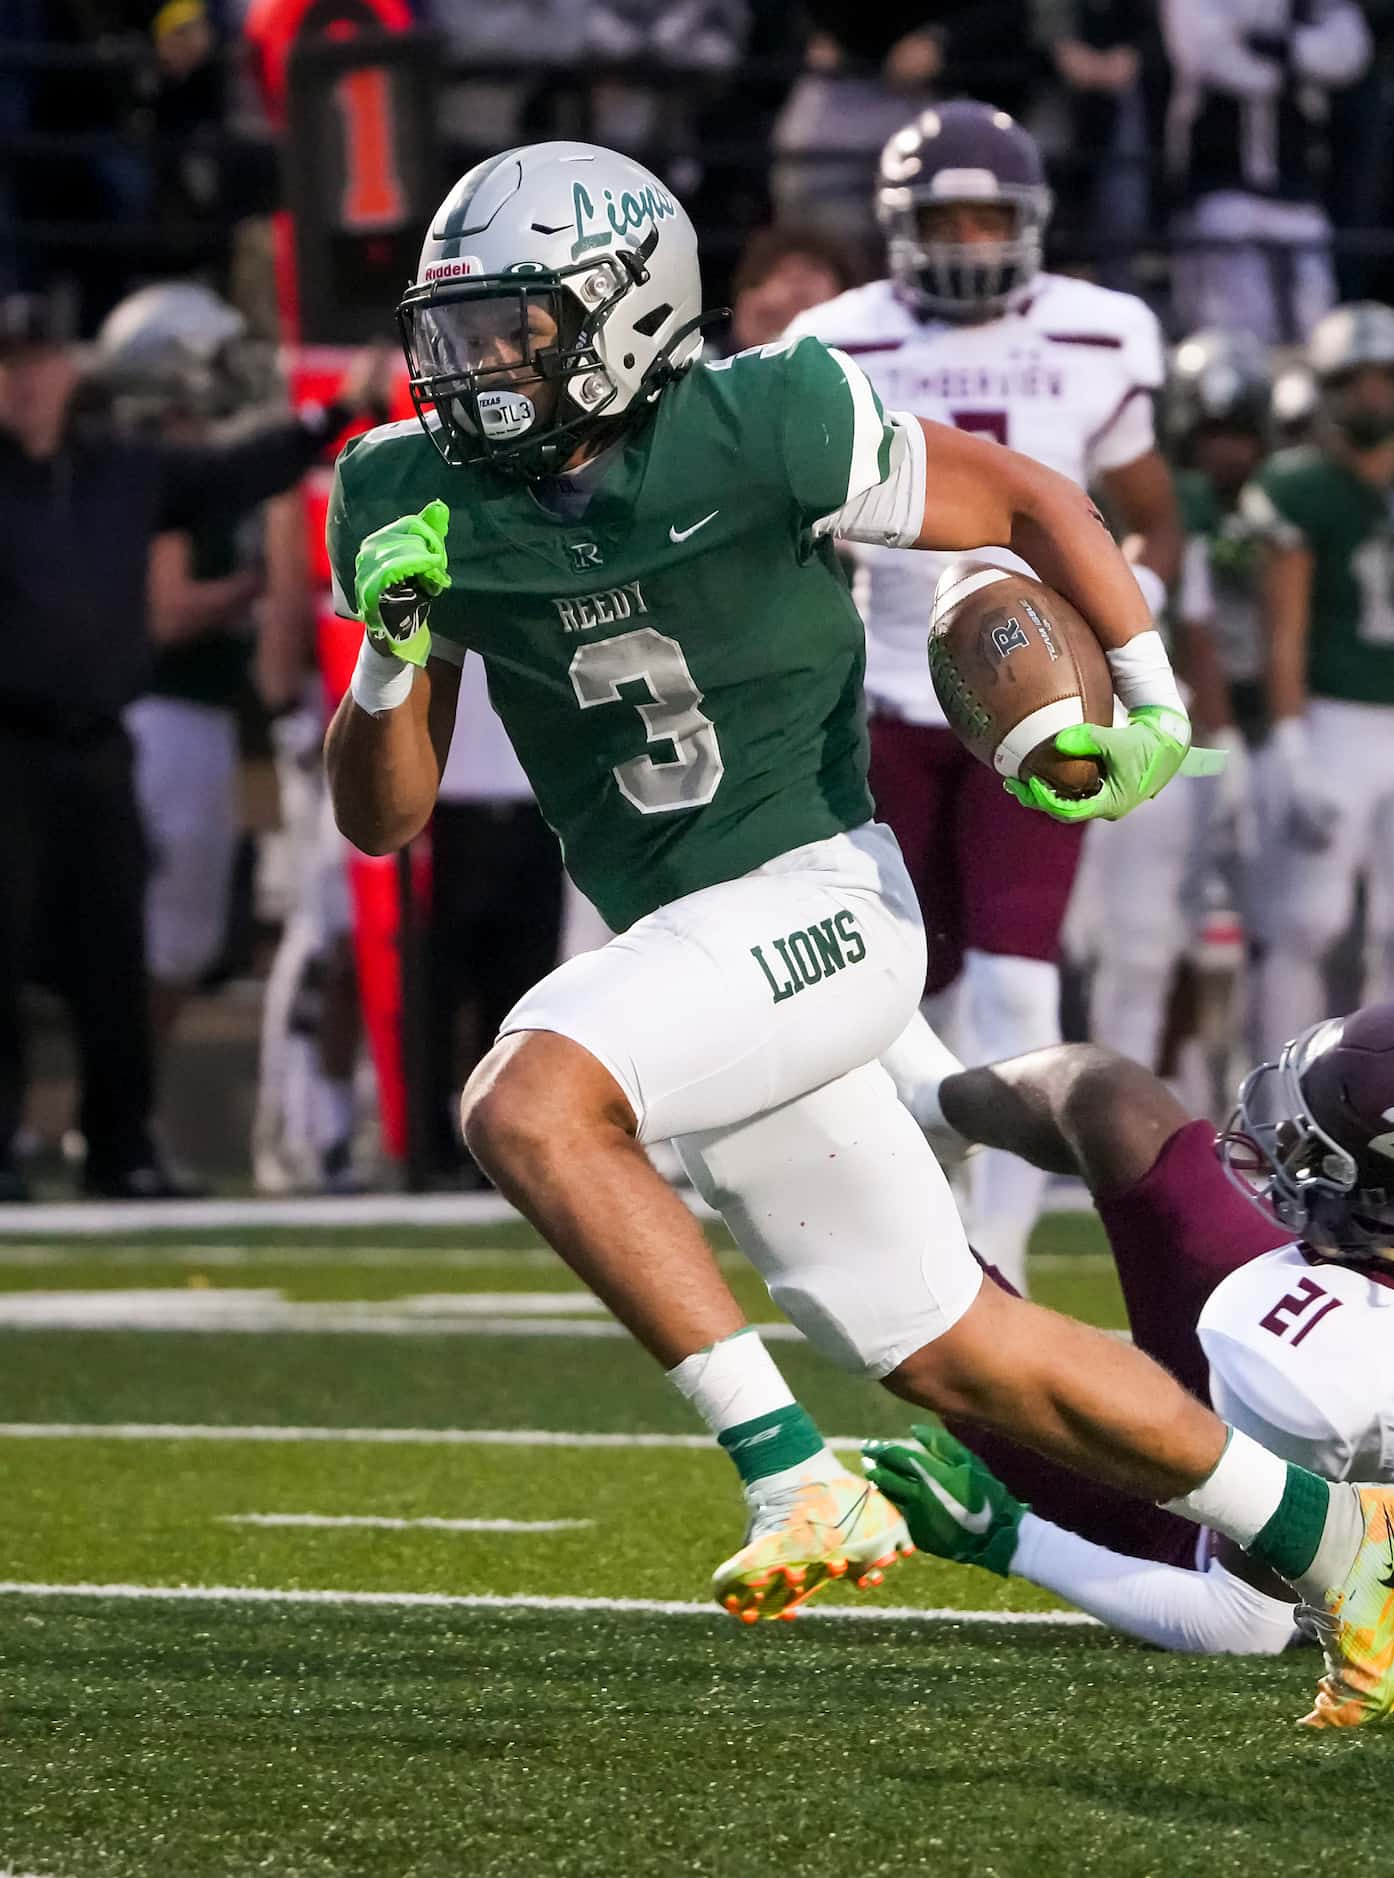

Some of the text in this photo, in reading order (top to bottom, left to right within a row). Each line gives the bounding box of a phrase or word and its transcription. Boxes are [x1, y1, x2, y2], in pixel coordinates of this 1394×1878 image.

[334, 66, 405, 228] 1
[552, 580, 648, 633] REEDY
[992, 617, 1030, 658] R
[568, 627, 725, 815] 3
[750, 909, 867, 1005] LIONS
[1258, 1277, 1344, 1348] 21
